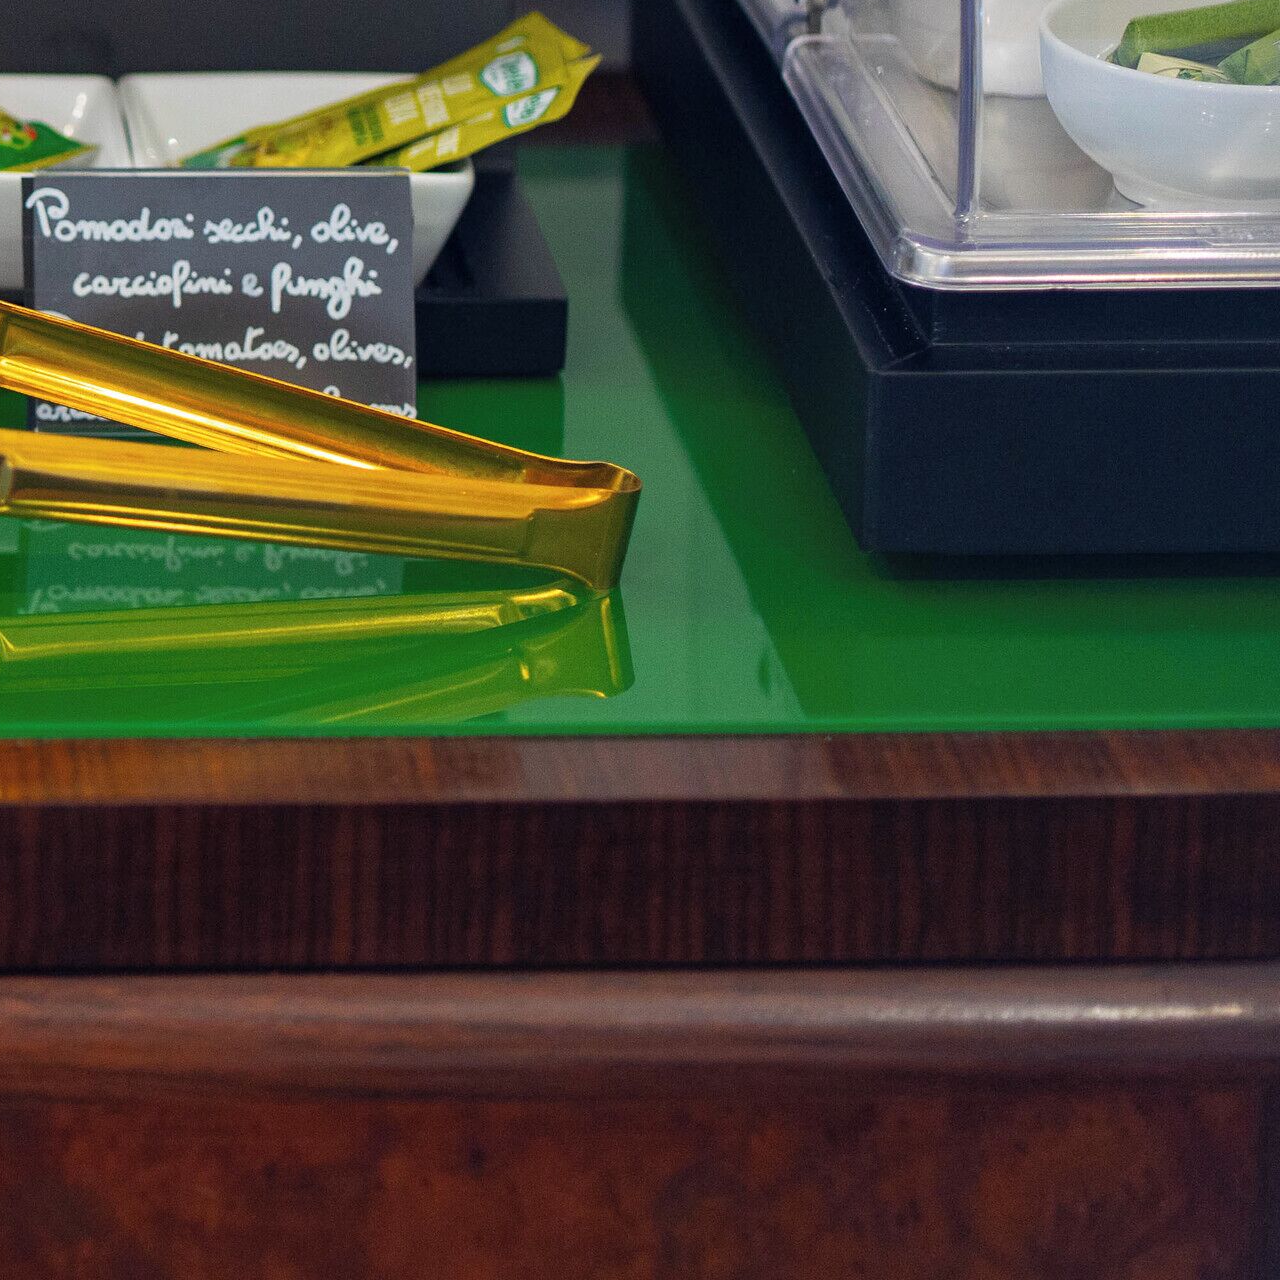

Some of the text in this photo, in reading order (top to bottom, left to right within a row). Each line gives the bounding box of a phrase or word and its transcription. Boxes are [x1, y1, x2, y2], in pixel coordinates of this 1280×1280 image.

[26, 187, 399, 254] Pomodori secchi, olive,
[72, 256, 382, 320] carciofini e funghi
[312, 327, 414, 369] olives,
